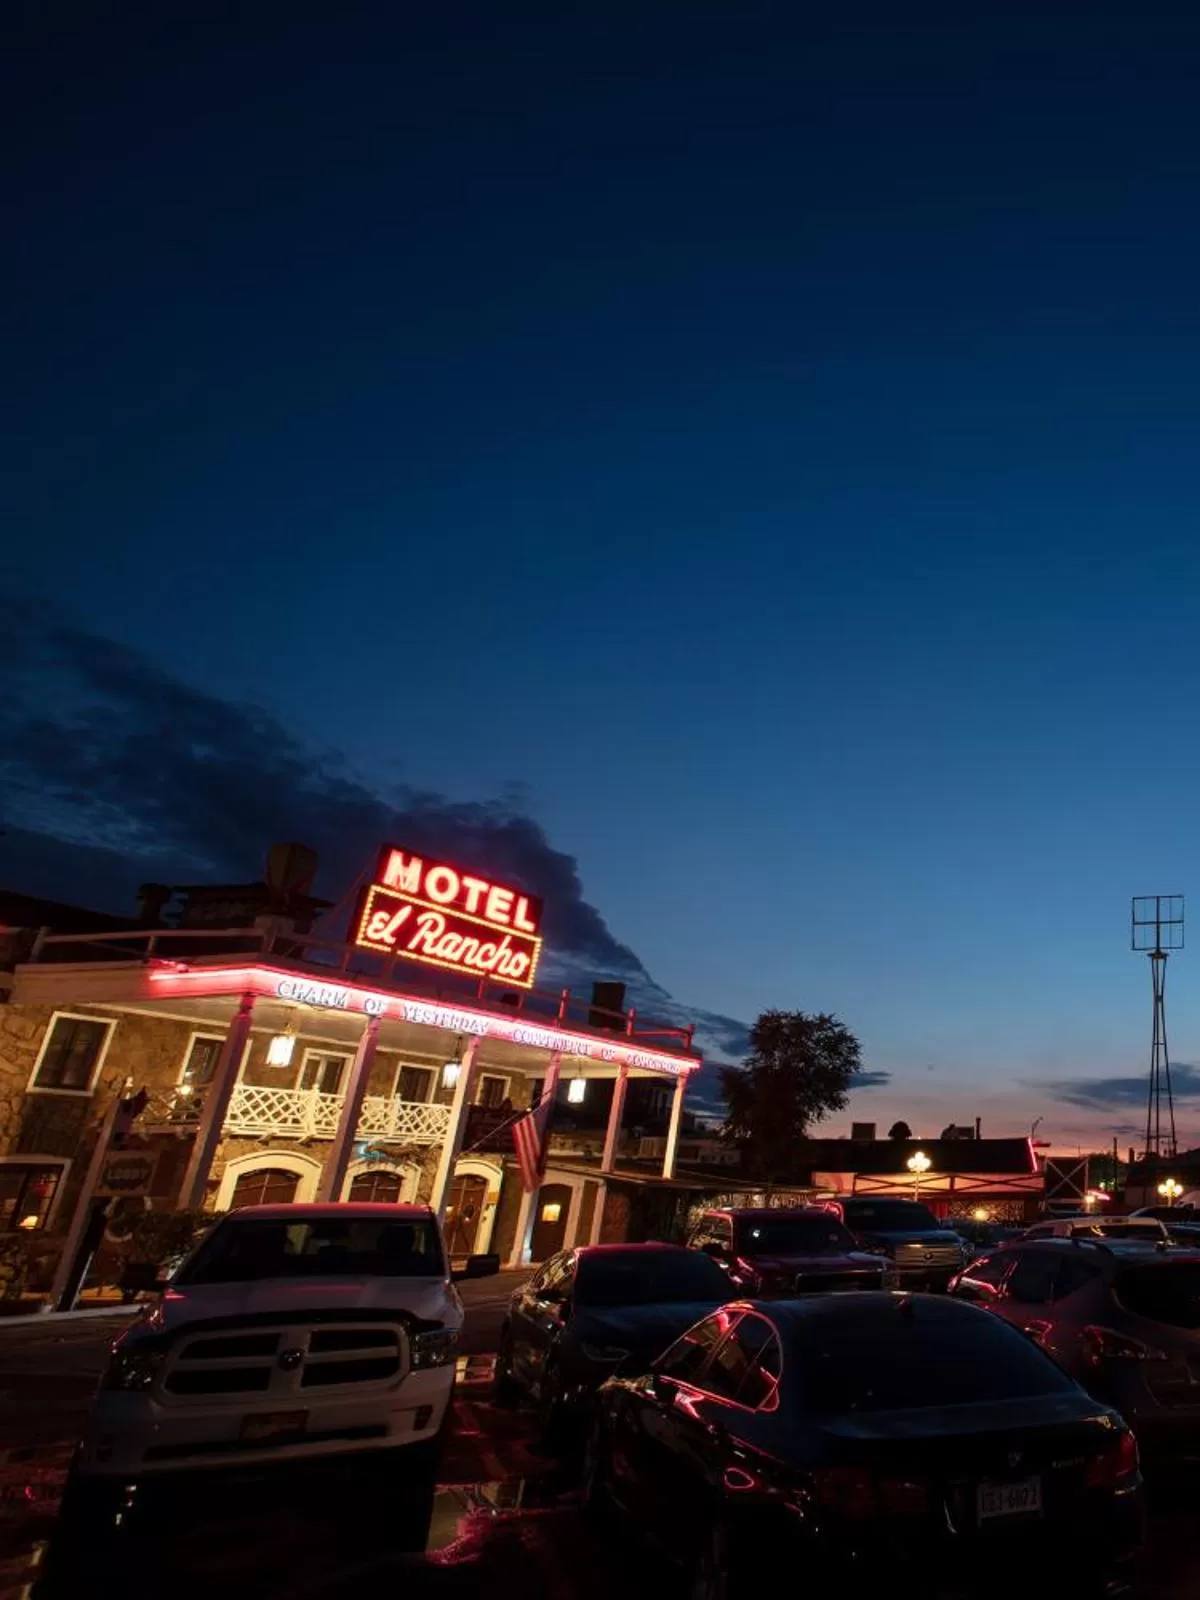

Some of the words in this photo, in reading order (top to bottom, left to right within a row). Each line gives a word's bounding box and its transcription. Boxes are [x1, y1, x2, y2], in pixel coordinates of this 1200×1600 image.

[382, 849, 536, 932] MOTEL
[408, 912, 530, 977] Rancho
[277, 980, 348, 1009] CHARM
[364, 997, 384, 1015] OF
[403, 1004, 489, 1034] YESTERDAY
